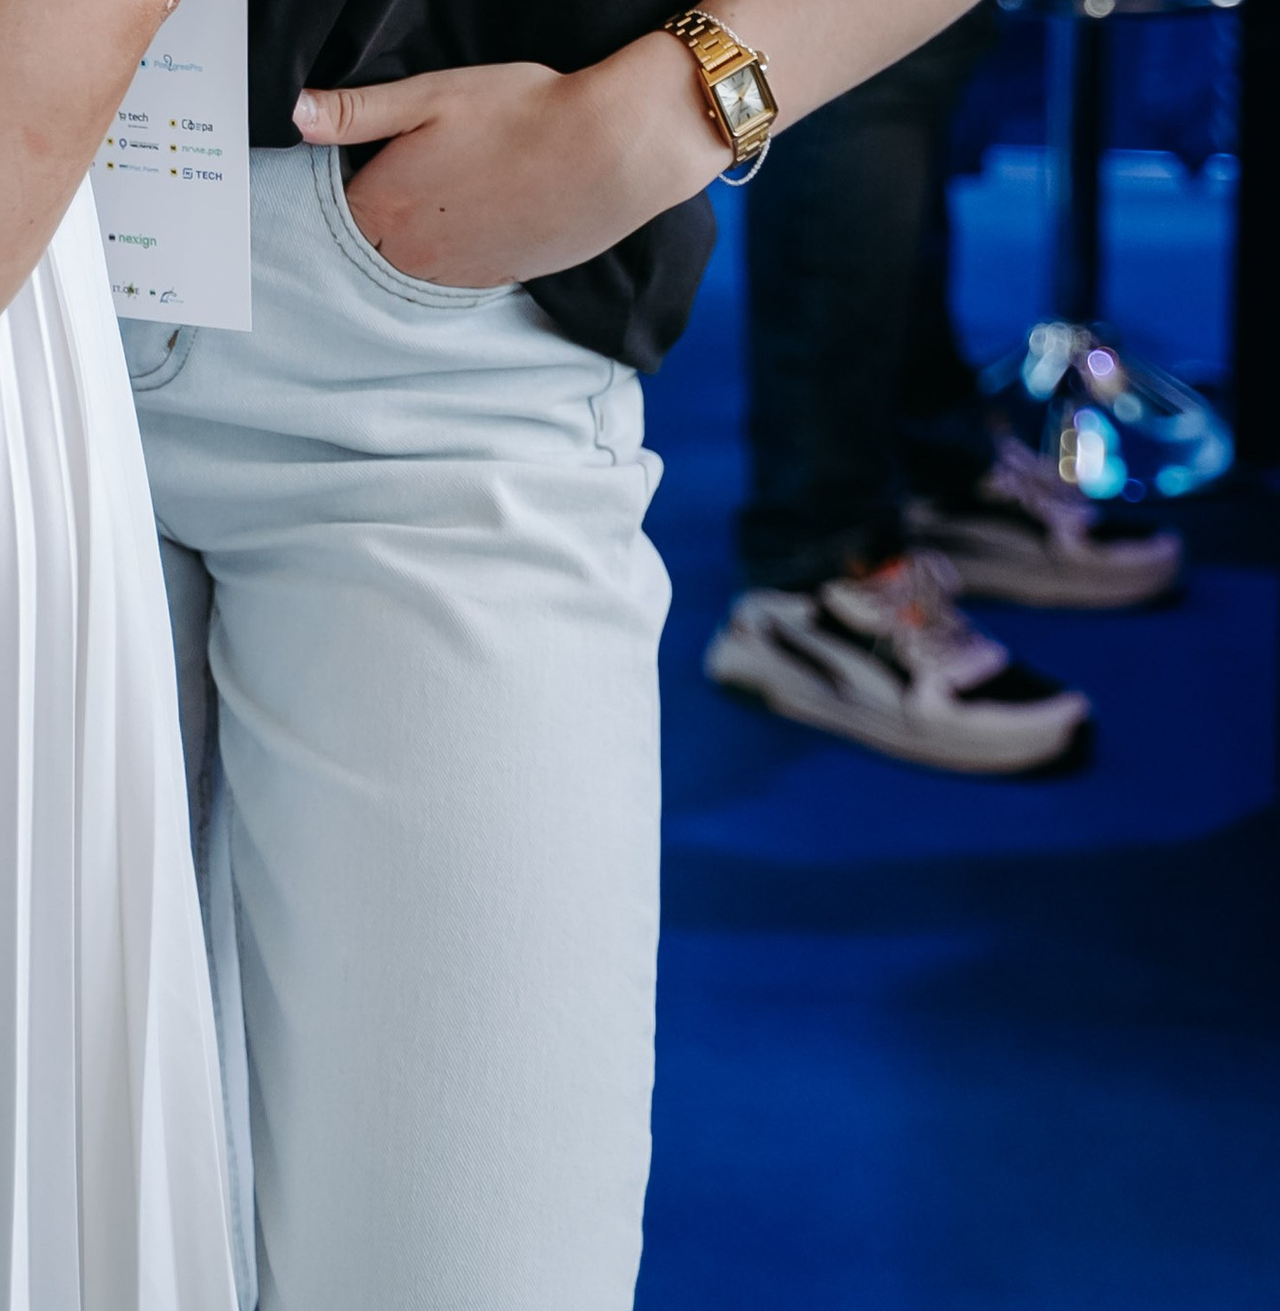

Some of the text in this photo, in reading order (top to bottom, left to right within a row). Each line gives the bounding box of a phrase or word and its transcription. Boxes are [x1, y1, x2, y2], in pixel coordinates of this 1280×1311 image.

[128, 112, 149, 122] tech
[195, 170, 222, 181] TECH
[118, 233, 157, 249] nexign
